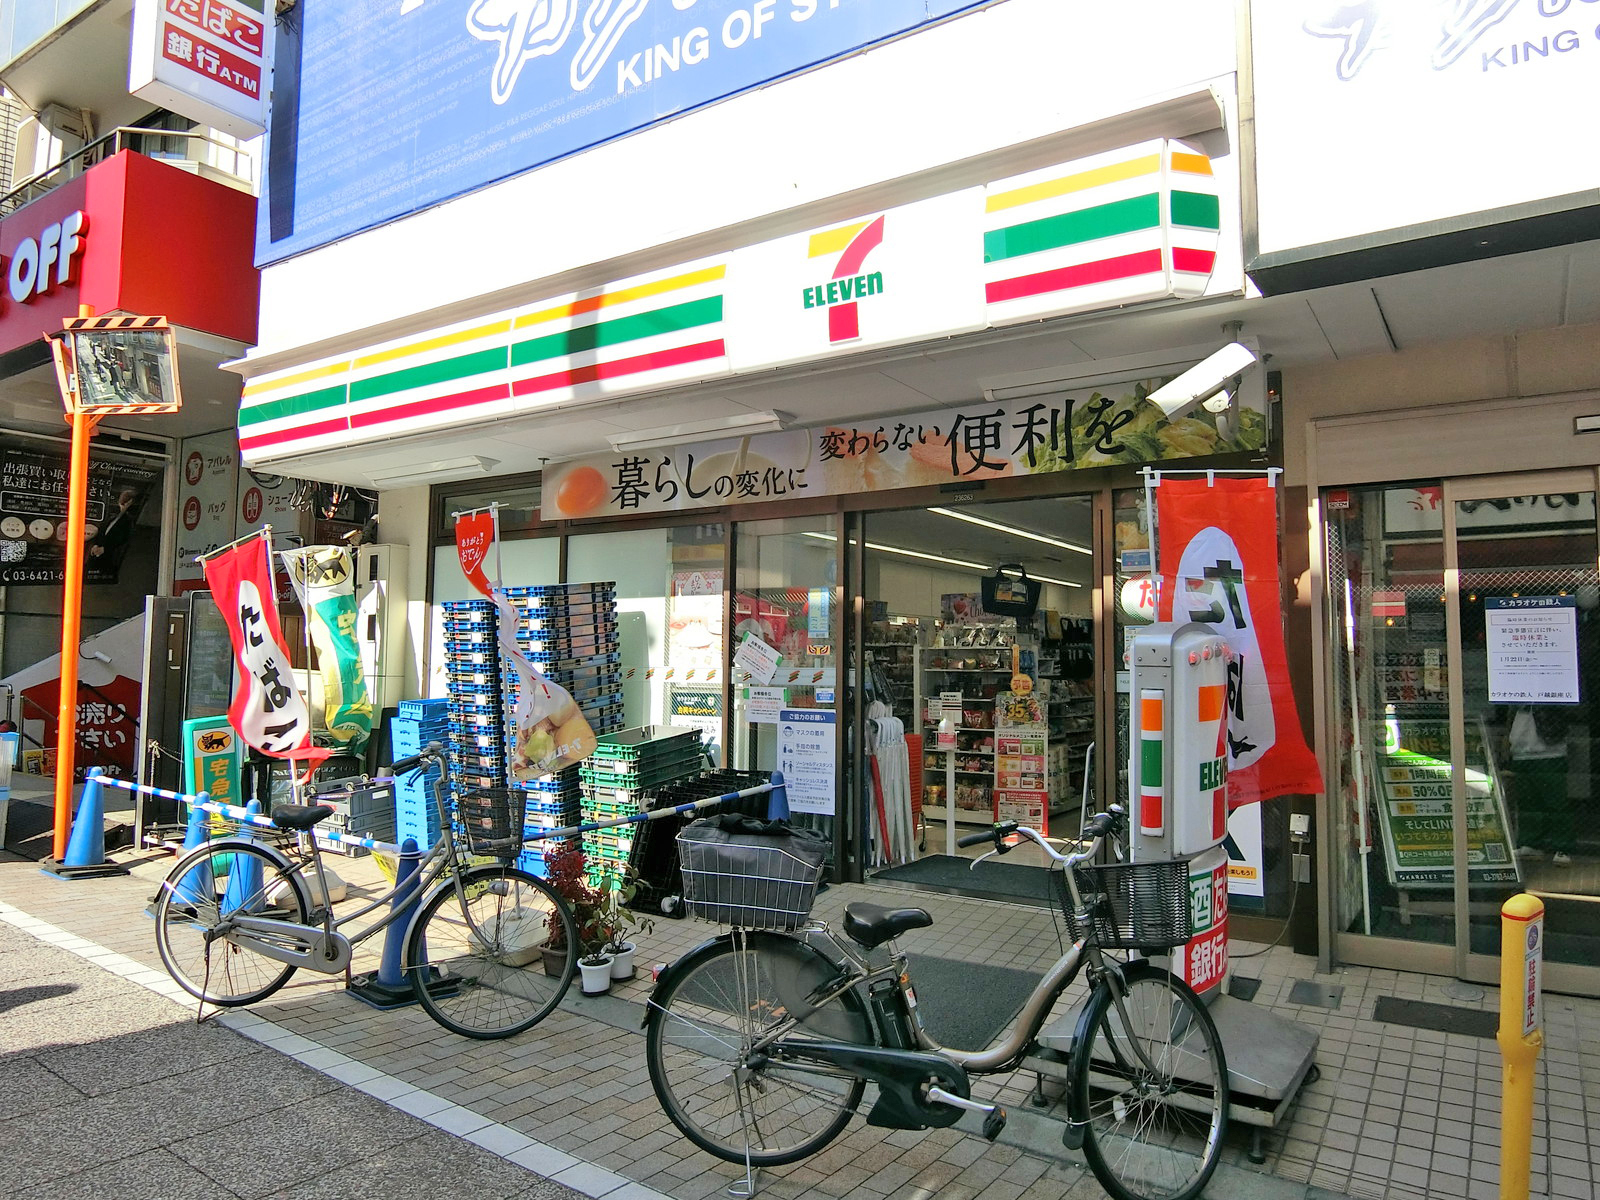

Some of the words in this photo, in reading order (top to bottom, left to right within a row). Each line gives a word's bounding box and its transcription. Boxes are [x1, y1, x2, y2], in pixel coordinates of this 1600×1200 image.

[170, 0, 260, 52] たばこ
[167, 31, 257, 92] 銀行ATM
[617, 27, 709, 94] KING
[722, 0, 776, 48] OF
[1482, 30, 1579, 72] KING
[9, 210, 83, 303] OFF
[820, 398, 1134, 476] 変わらない便利を
[3, 462, 68, 480] 出張買い取
[610, 454, 809, 510] 暮らしの変化に
[461, 532, 484, 548] ありがとう
[461, 547, 481, 563] おでん
[13, 570, 65, 581] 03-6421-6
[1385, 685, 1448, 701] 営業中で
[788, 713, 826, 721] ご協力のお願い
[1405, 727, 1450, 736] カラオケの
[208, 758, 232, 805] 宅急
[1413, 785, 1453, 797] 50%OF
[1395, 831, 1453, 841] いつでもカラ
[1190, 932, 1228, 988] 銀行
